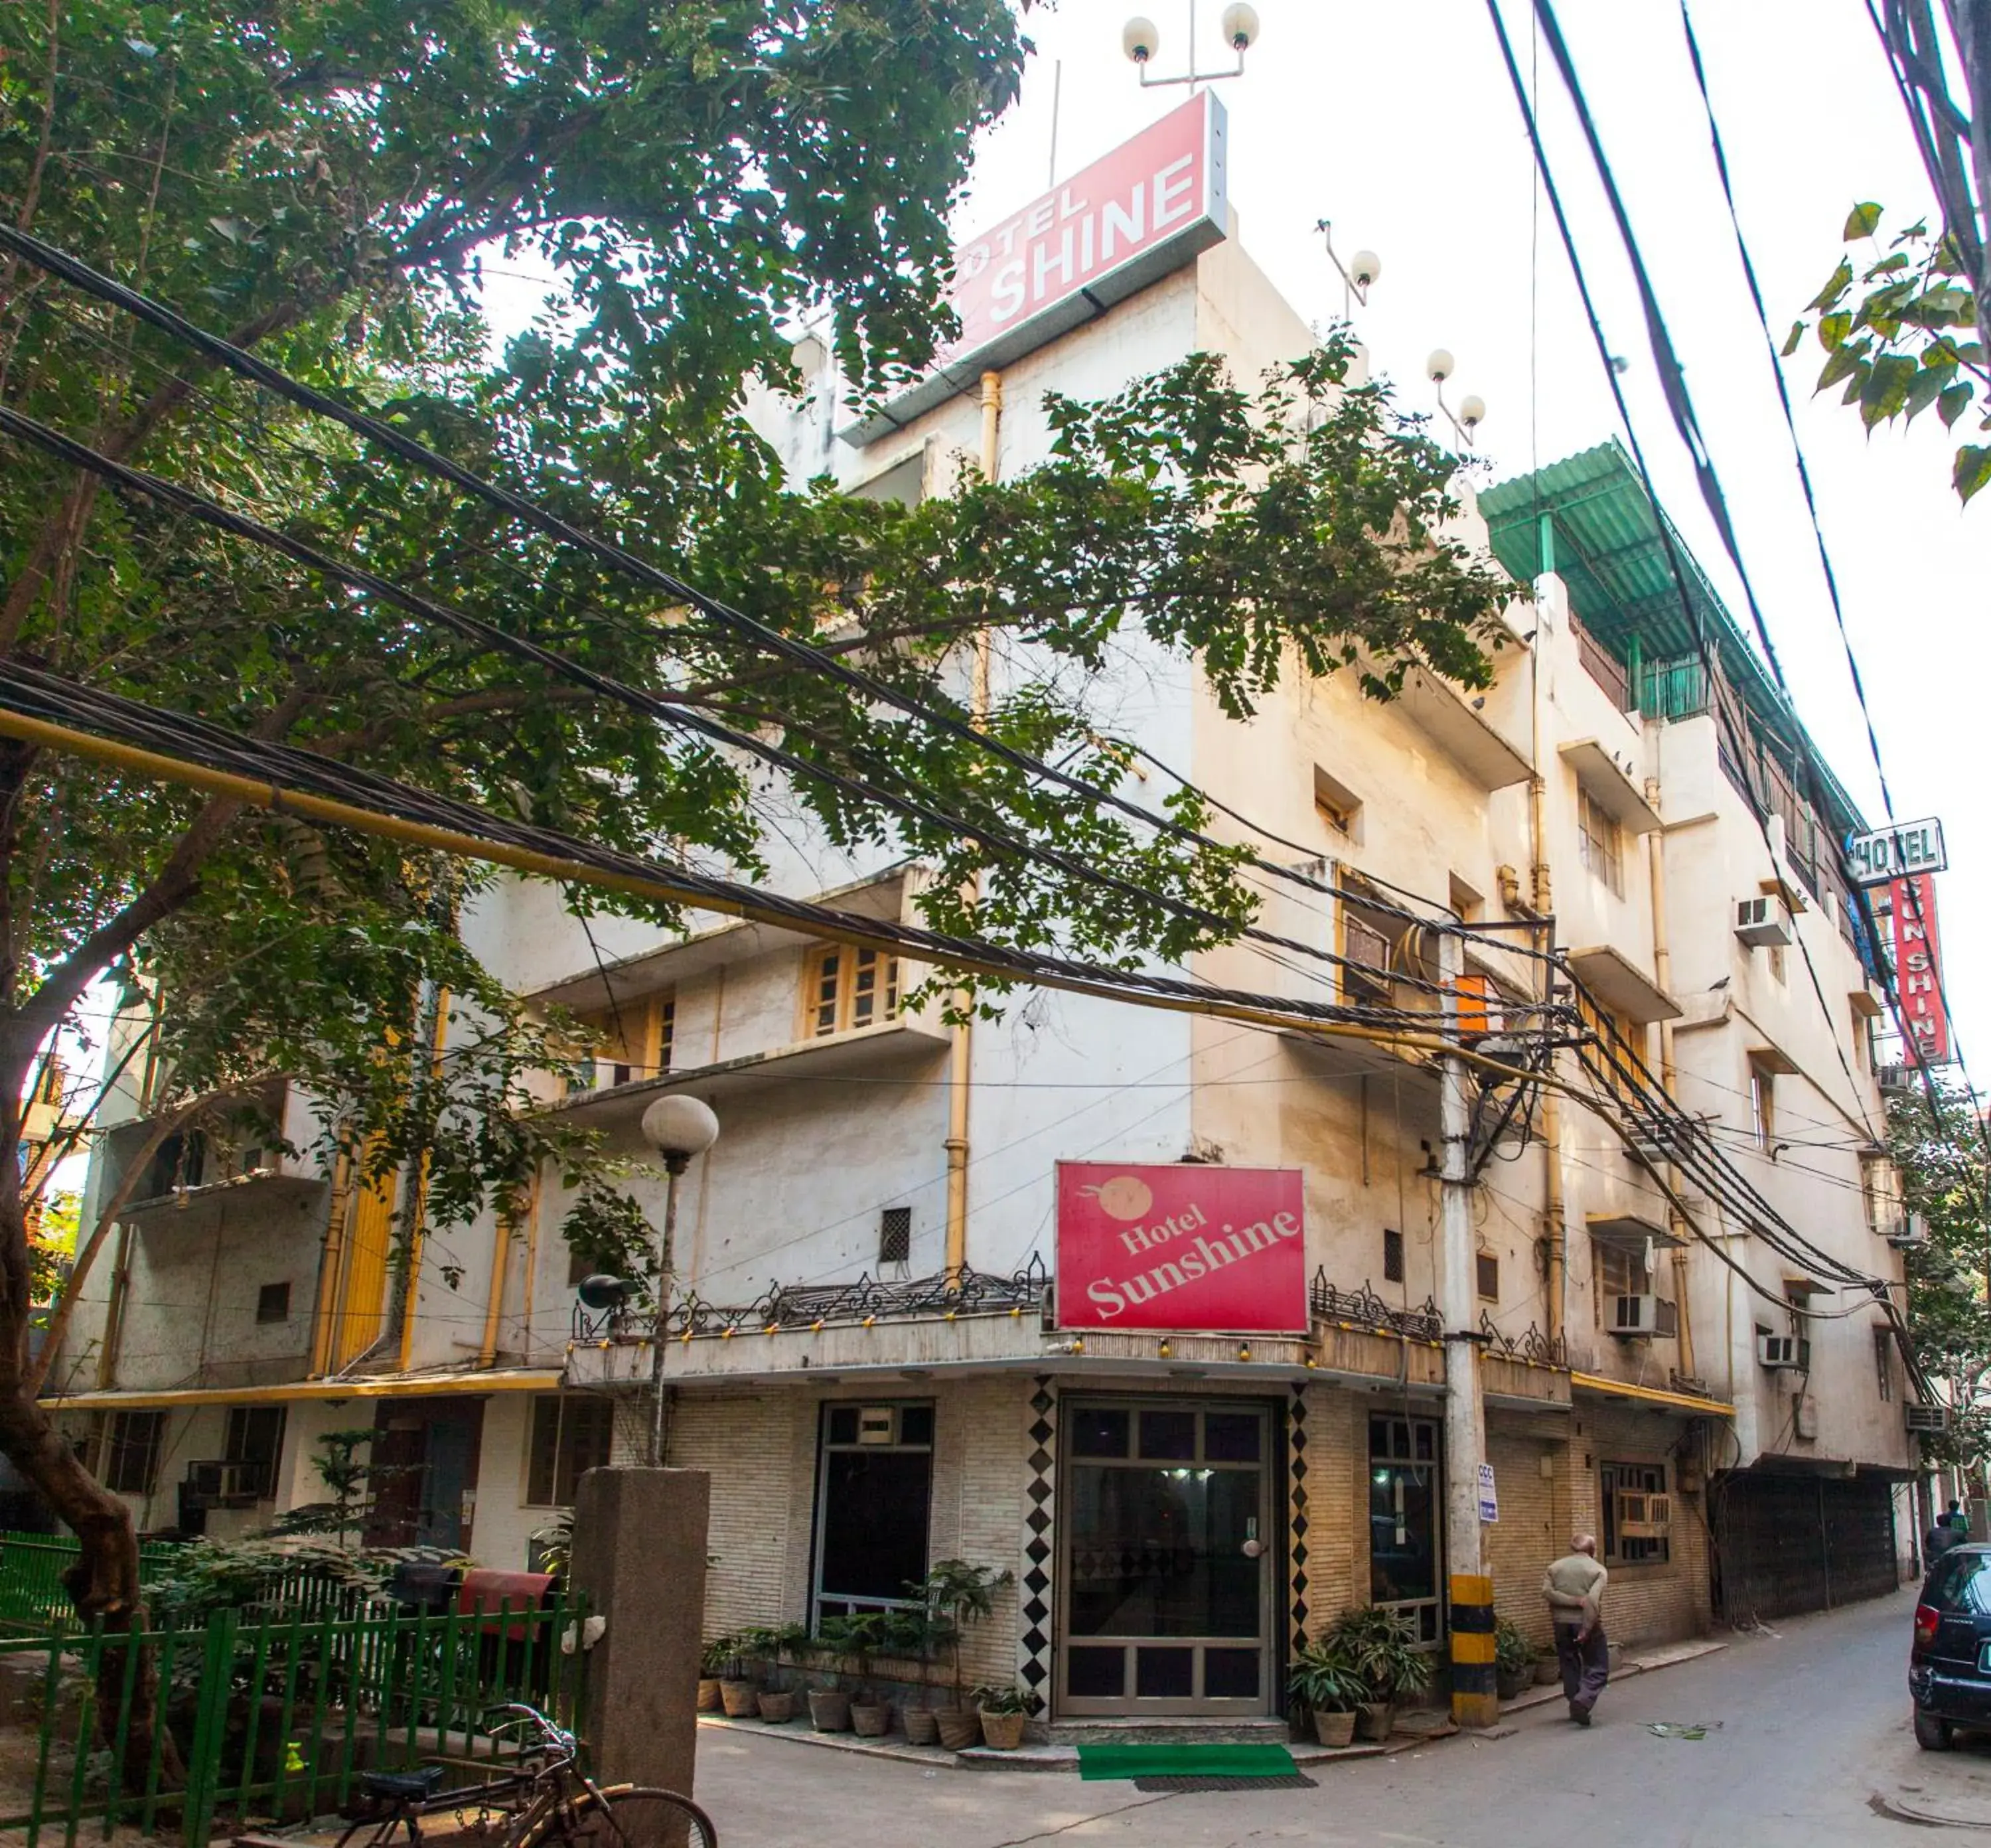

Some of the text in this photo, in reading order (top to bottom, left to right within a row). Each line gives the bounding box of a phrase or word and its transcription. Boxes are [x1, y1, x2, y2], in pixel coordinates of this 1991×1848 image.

[961, 187, 1088, 280] OTEL
[990, 152, 1193, 323] SHINE
[1855, 829, 1935, 875] HOTEL
[1086, 1211, 1300, 1320] Sunshine
[1118, 1203, 1208, 1255] Hotel
